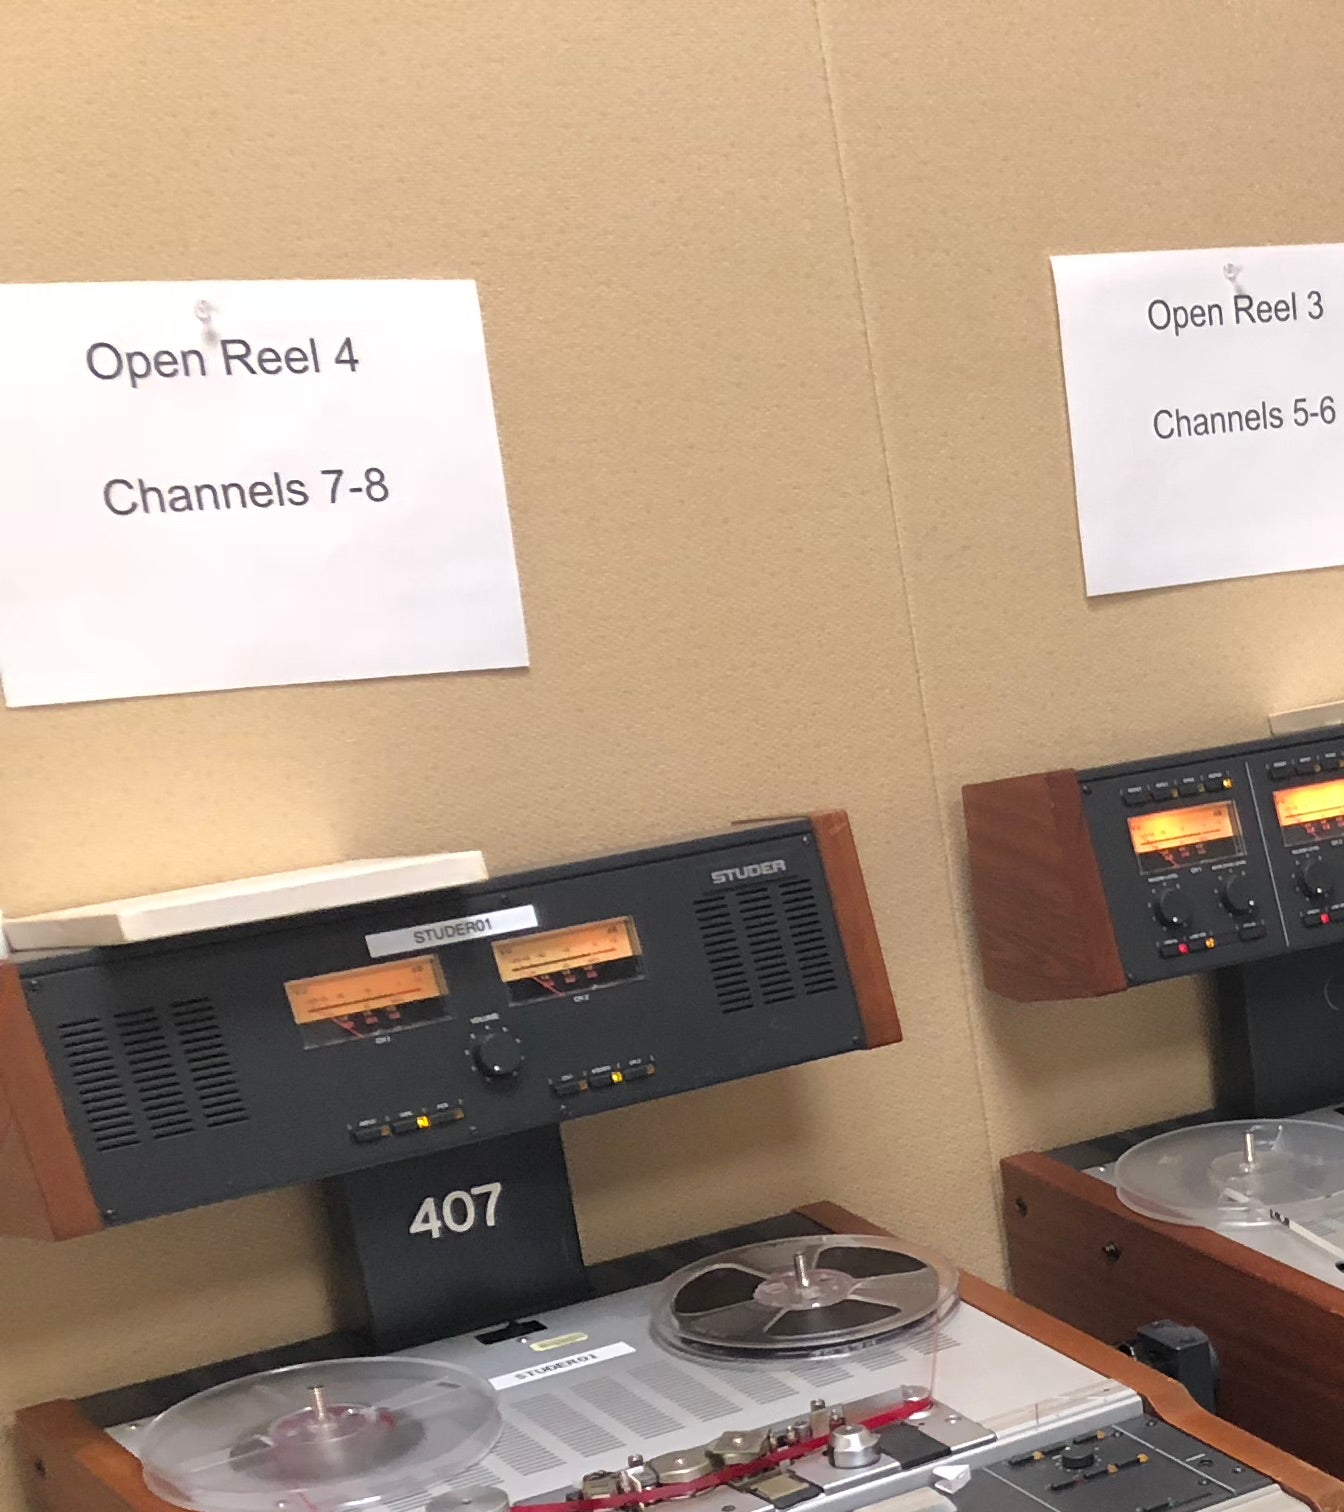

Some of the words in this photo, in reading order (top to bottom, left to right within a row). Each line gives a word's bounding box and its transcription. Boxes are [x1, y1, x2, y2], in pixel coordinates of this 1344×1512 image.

[1148, 299, 1223, 336] Open
[1233, 291, 1297, 324] Reel
[1307, 290, 1324, 320] 3
[86, 342, 207, 388] Open
[220, 337, 320, 376] Reel
[334, 337, 359, 371] 4
[1153, 401, 1284, 439] Channels
[1293, 395, 1336, 426] 5-6
[103, 471, 309, 515] Channels
[321, 467, 389, 503] 7-8
[711, 859, 786, 884] STUDER
[413, 918, 493, 944] STUDER01
[409, 1182, 502, 1239] 407
